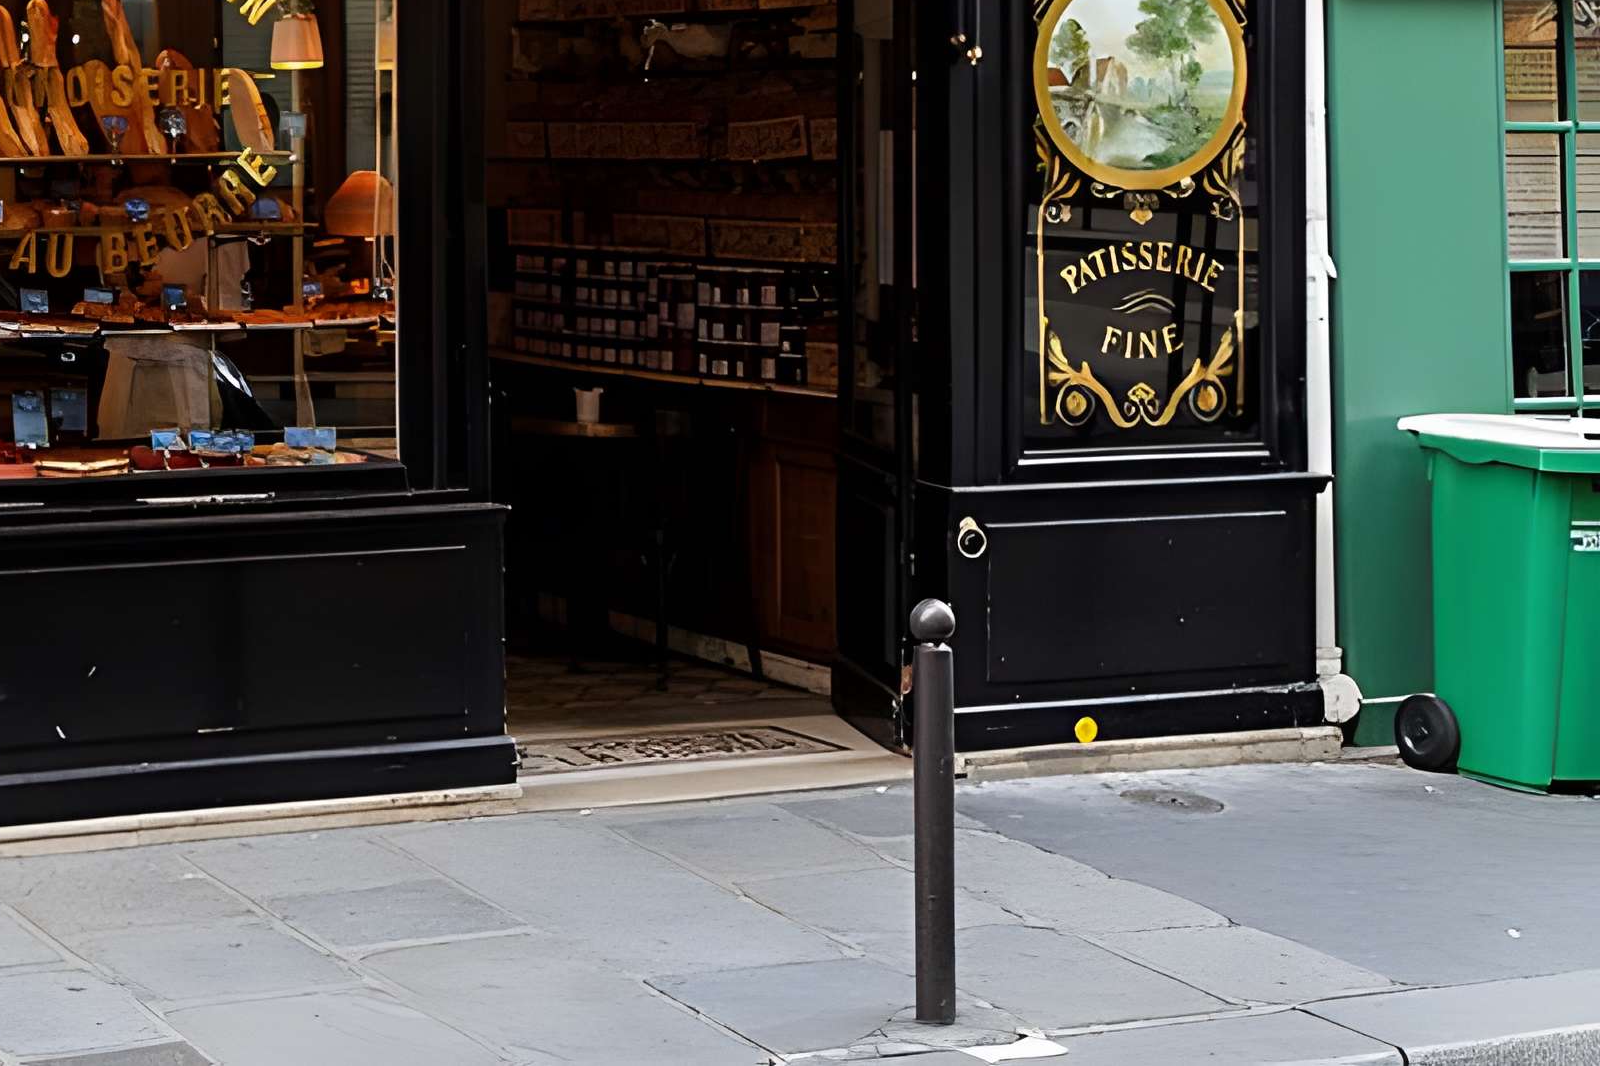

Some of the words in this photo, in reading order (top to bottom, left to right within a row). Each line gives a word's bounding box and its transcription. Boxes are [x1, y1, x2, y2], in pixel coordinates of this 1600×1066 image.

[9, 232, 73, 279] AU
[1059, 241, 1225, 294] PATISSERIE
[1100, 323, 1184, 359] FINE
